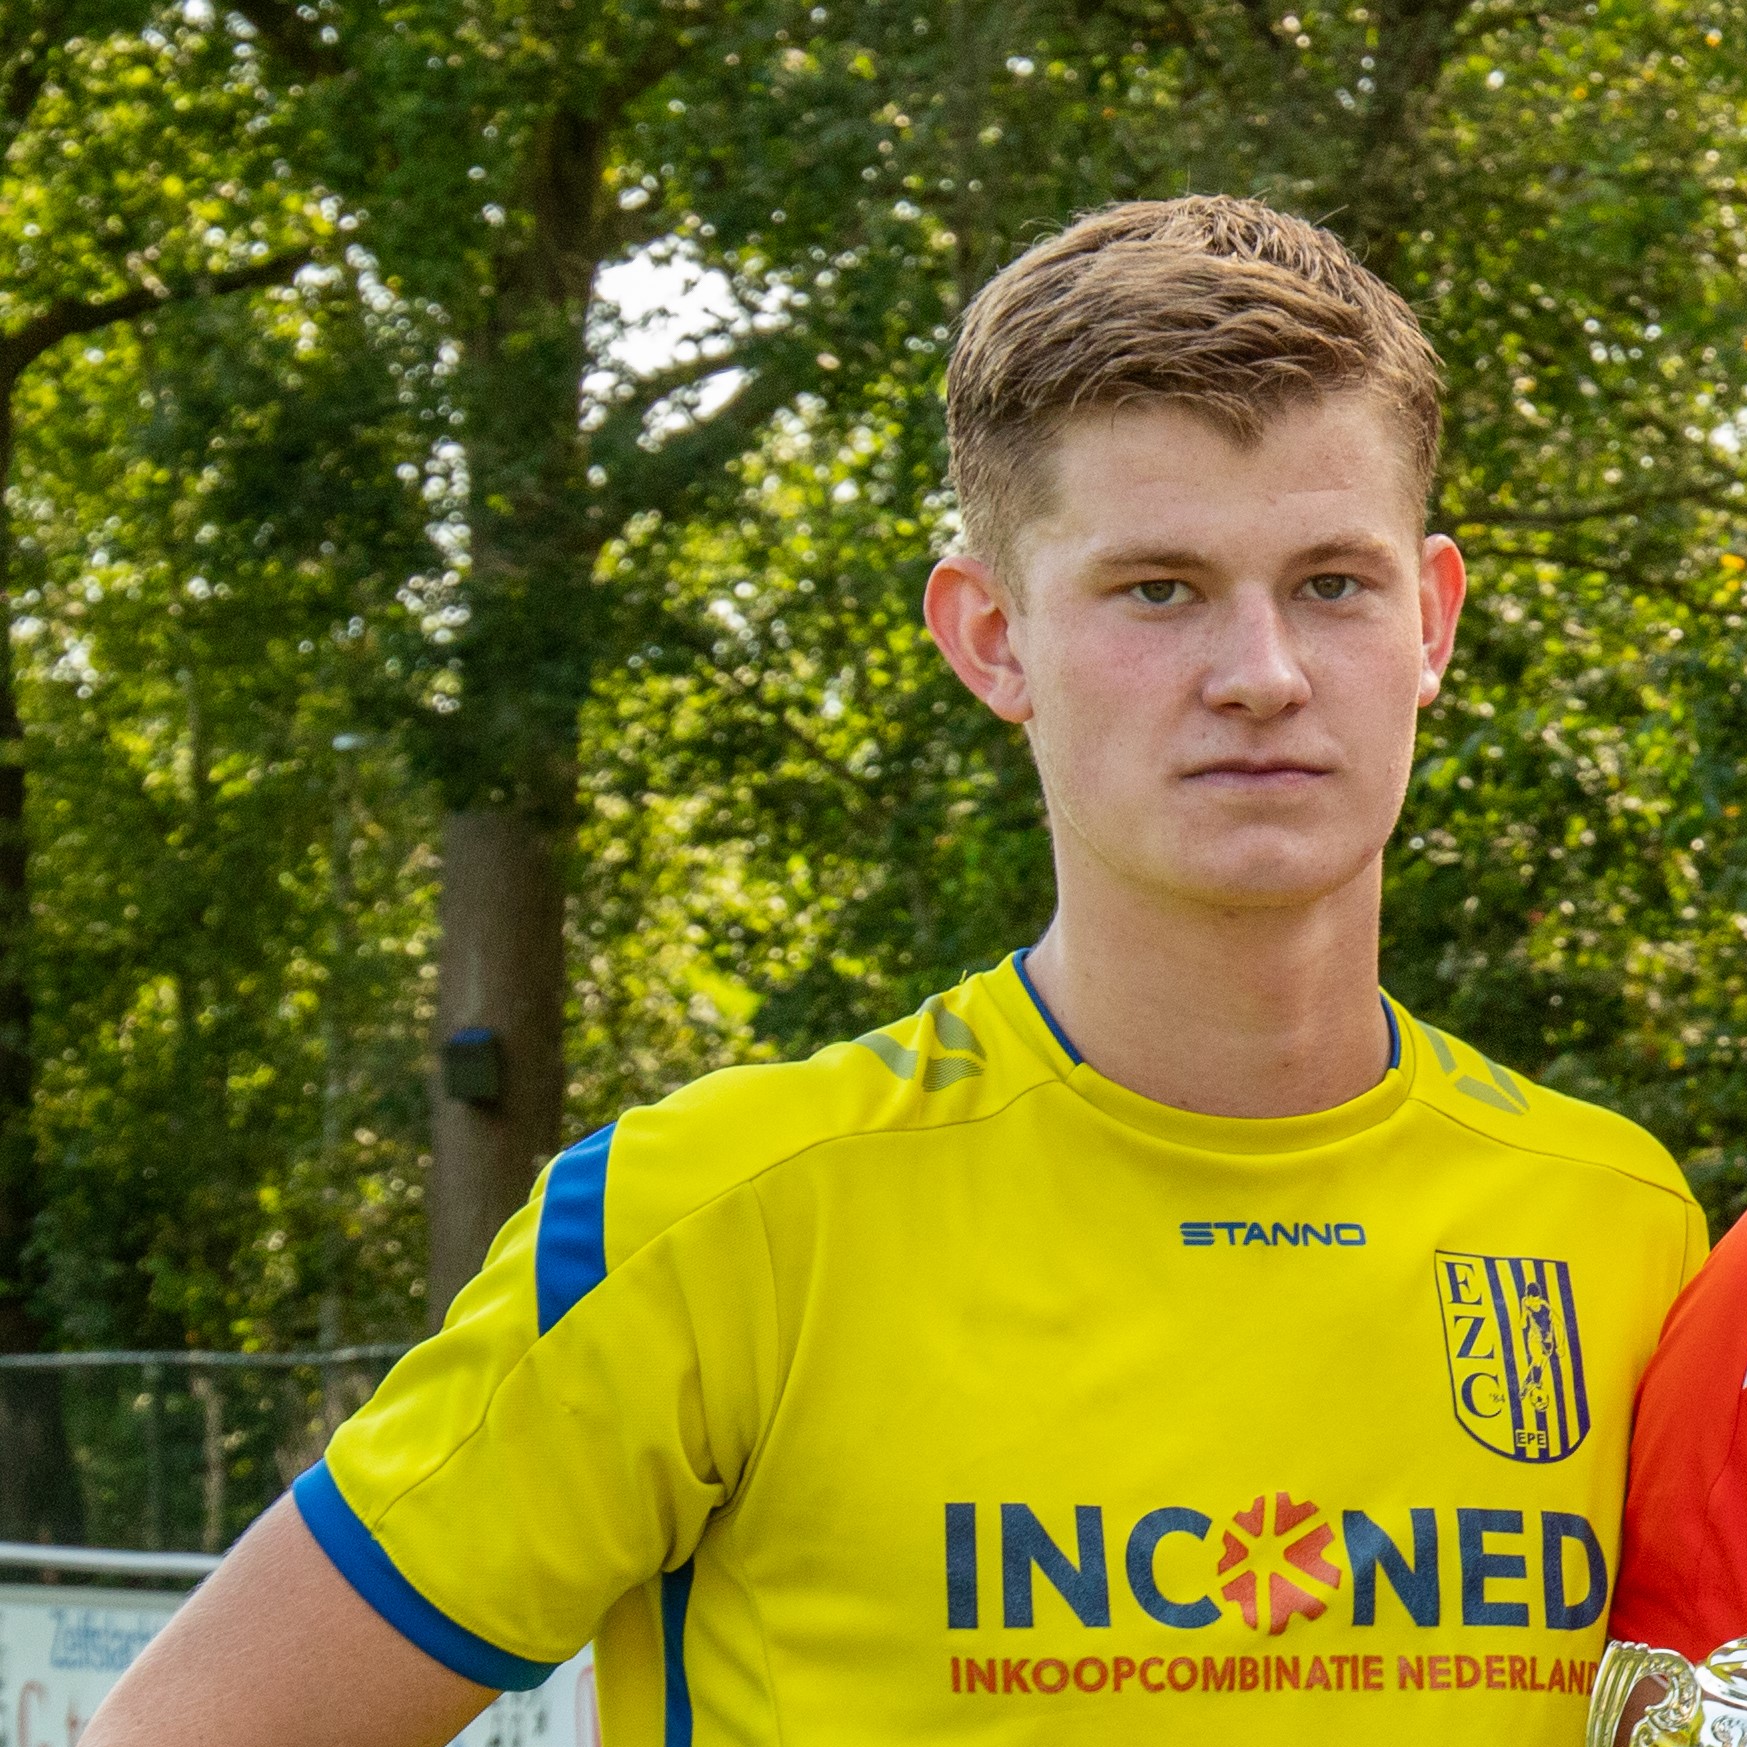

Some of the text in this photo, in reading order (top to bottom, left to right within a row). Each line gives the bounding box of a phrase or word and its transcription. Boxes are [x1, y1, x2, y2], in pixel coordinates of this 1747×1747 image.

[1179, 1221, 1367, 1247] STANNO
[1516, 1431, 1547, 1446] EPE
[949, 1655, 1385, 1695] INKOOPCOMBINATIE
